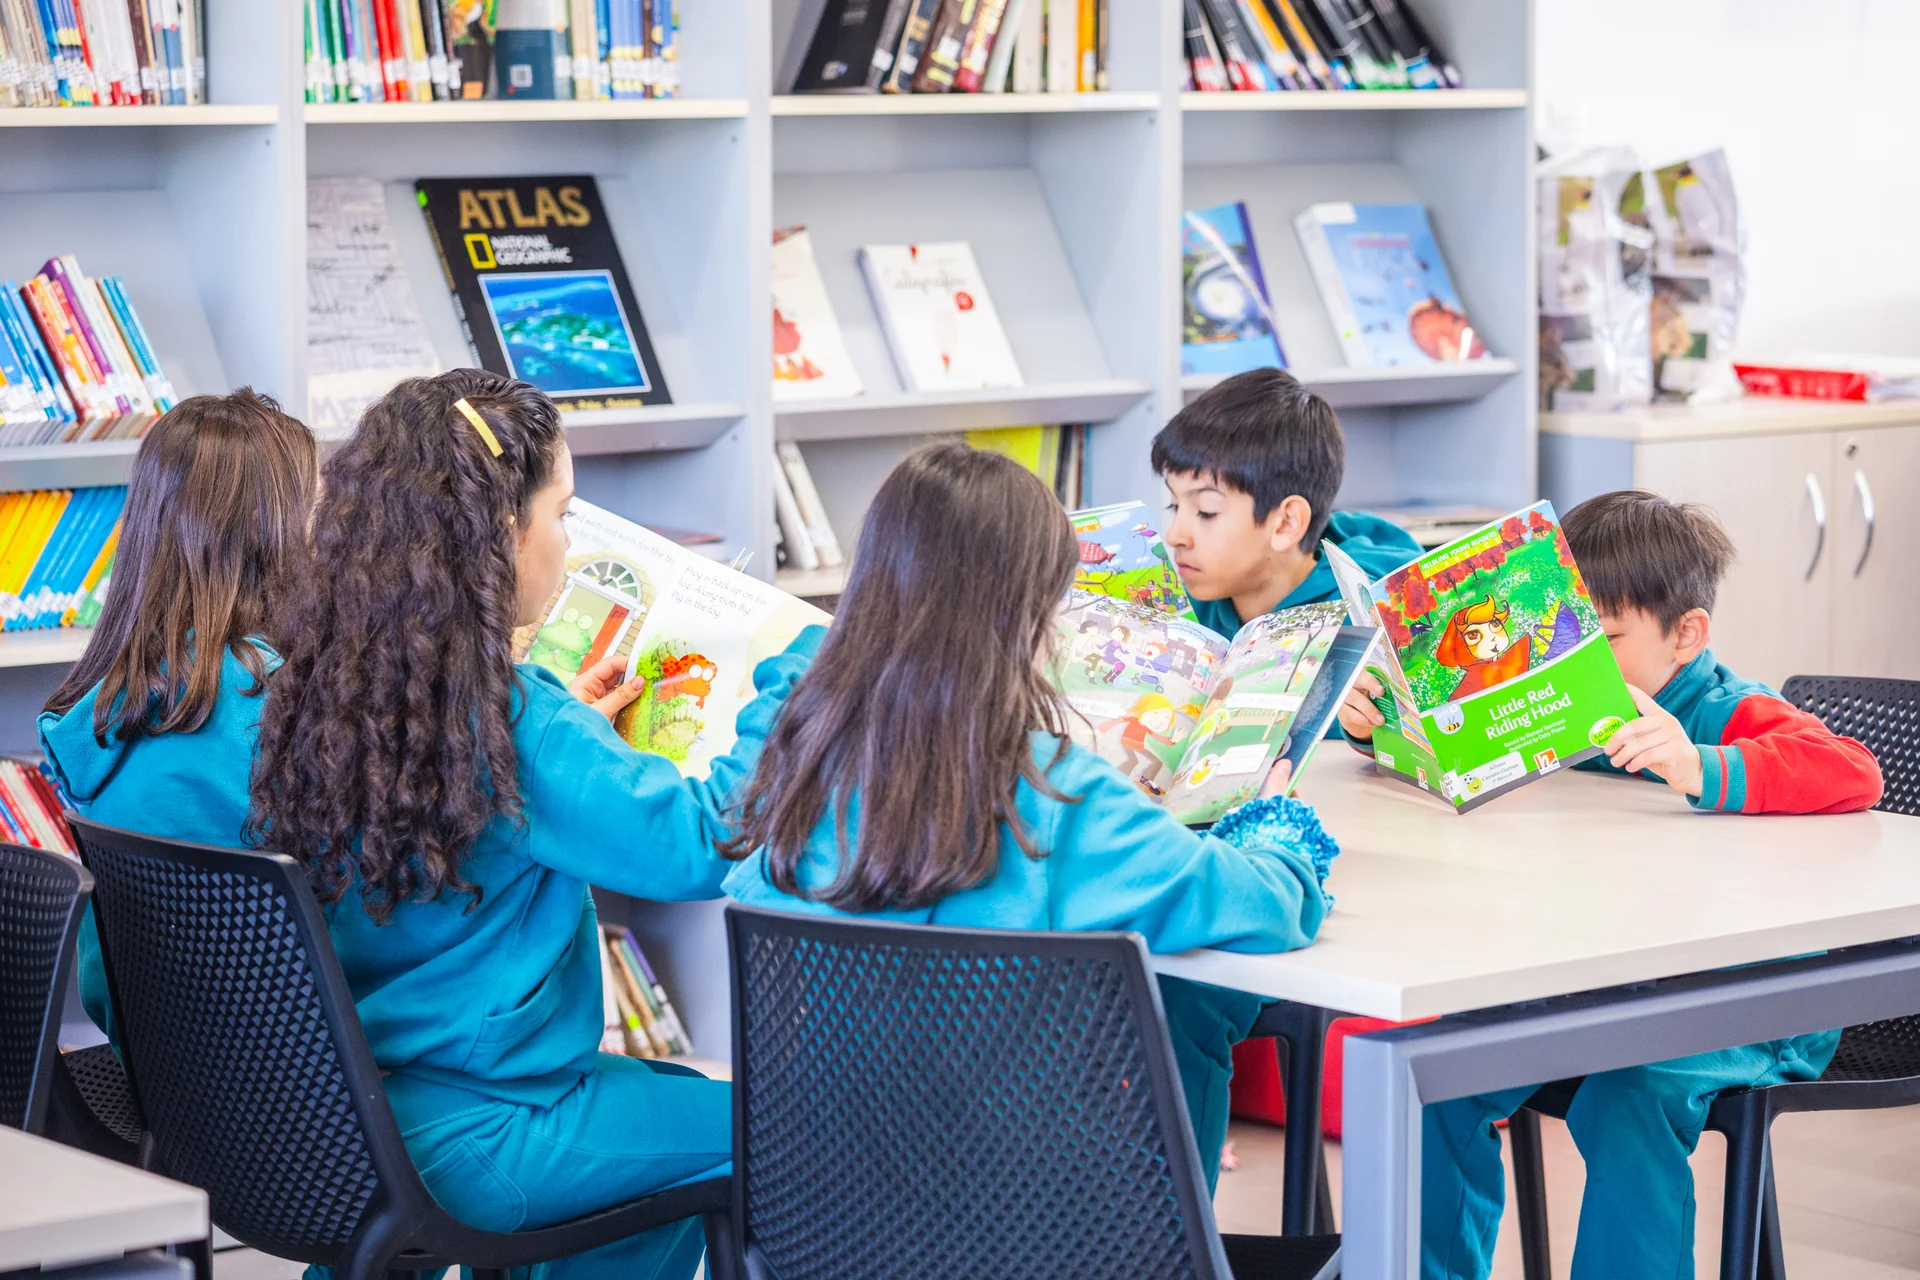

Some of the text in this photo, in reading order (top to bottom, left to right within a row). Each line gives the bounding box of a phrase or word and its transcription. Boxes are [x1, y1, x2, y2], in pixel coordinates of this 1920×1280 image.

[458, 185, 591, 229] ATLAS
[490, 234, 553, 250] NATIONAL
[494, 246, 573, 265] GEOGRAPHIC
[637, 540, 650, 552] for
[651, 546, 664, 559] the
[1421, 531, 1497, 571] HELBLING YOUNG READERS
[671, 590, 684, 604] Pig
[684, 596, 693, 606] in
[694, 599, 707, 612] the
[685, 565, 703, 581] Frog
[742, 591, 754, 601] on
[754, 593, 767, 606] his
[693, 585, 718, 603] Along
[738, 603, 752, 617] Big
[1485, 692, 1573, 740] Riding Hood
[1488, 681, 1556, 721] Little Red
[1503, 738, 1520, 748] Retold
[1525, 728, 1544, 738] Richard
